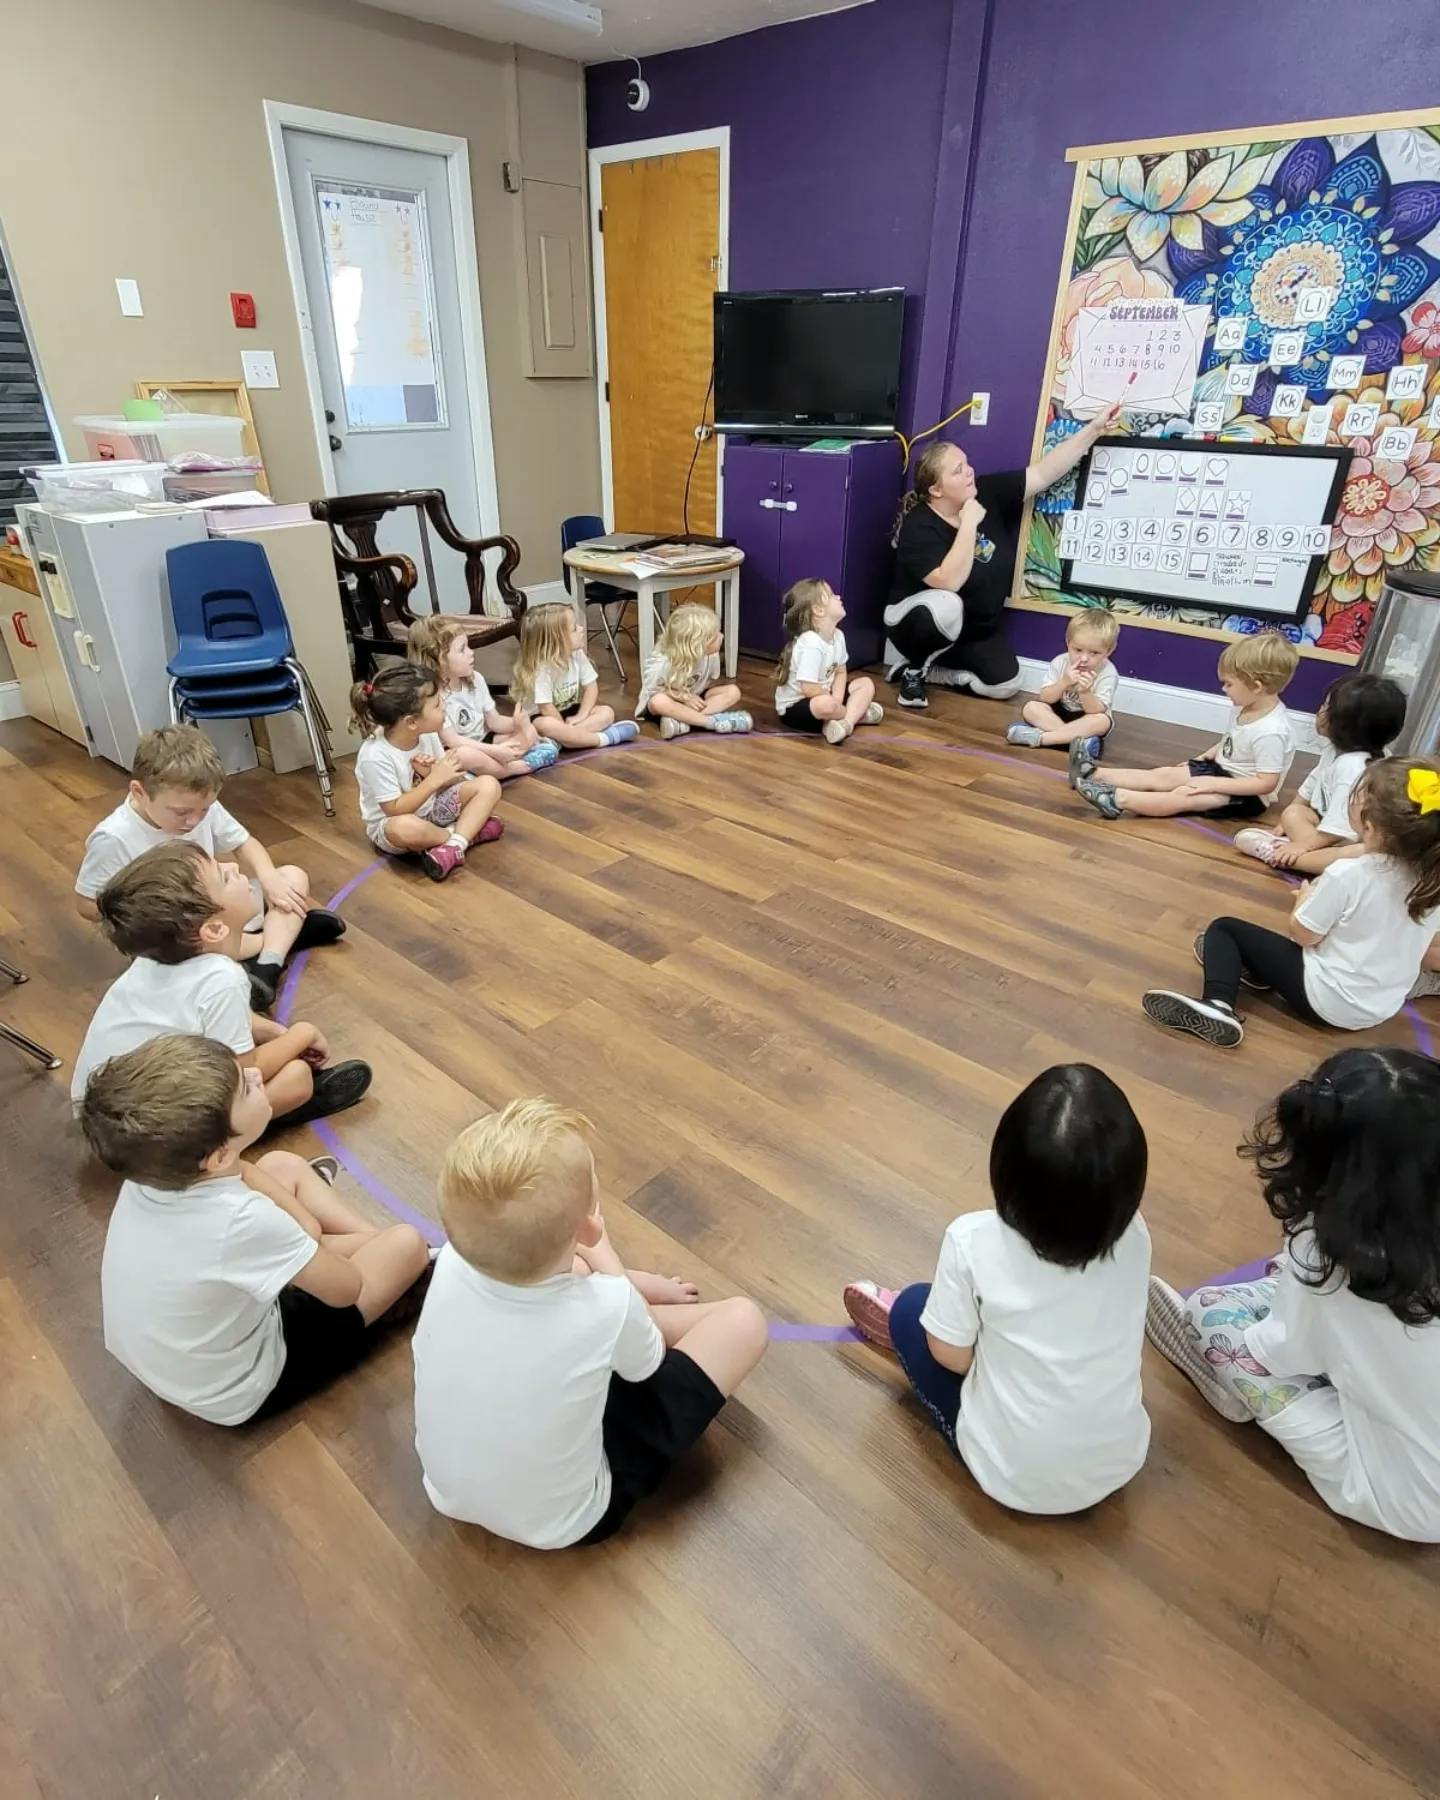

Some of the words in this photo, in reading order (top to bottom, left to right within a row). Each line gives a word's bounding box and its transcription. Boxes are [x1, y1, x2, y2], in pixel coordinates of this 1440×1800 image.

[1109, 305, 1179, 320] SEPTEMBER
[1145, 330, 1153, 341] 1
[1159, 329, 1167, 340] 2
[1173, 330, 1181, 341] 3
[1221, 328, 1241, 340] Aa
[1094, 344, 1101, 352] 4
[1107, 344, 1115, 353] 5
[1119, 344, 1127, 354] 6
[1132, 345, 1140, 354] 7
[1145, 343, 1152, 355] 8
[1158, 344, 1164, 355] 9
[1169, 344, 1180, 353] 10
[1277, 343, 1296, 355] Ee
[1090, 358, 1097, 366] 11
[1115, 357, 1125, 367] 13
[1128, 358, 1137, 367] 14
[1141, 359, 1150, 369] 15
[1153, 360, 1165, 370] 16
[1333, 369, 1357, 378] Mm
[1230, 374, 1251, 386] Dd
[1393, 376, 1418, 388] Hh
[1279, 394, 1297, 407] Kk
[1350, 412, 1370, 428] Rr
[1384, 436, 1407, 450] Bb
[1093, 523, 1103, 538] 2
[1119, 522, 1129, 538] 3
[1144, 522, 1156, 537] 4
[1171, 524, 1184, 541] 5
[1196, 526, 1209, 543] 6
[1228, 526, 1240, 543] 7
[1255, 529, 1268, 546] 8
[1280, 531, 1294, 546] 9
[1305, 532, 1325, 547] 10
[1066, 540, 1078, 553] 11
[1086, 545, 1100, 558] 12
[1111, 547, 1126, 561] 13
[1137, 551, 1150, 561] 14
[1165, 554, 1178, 567] 15
